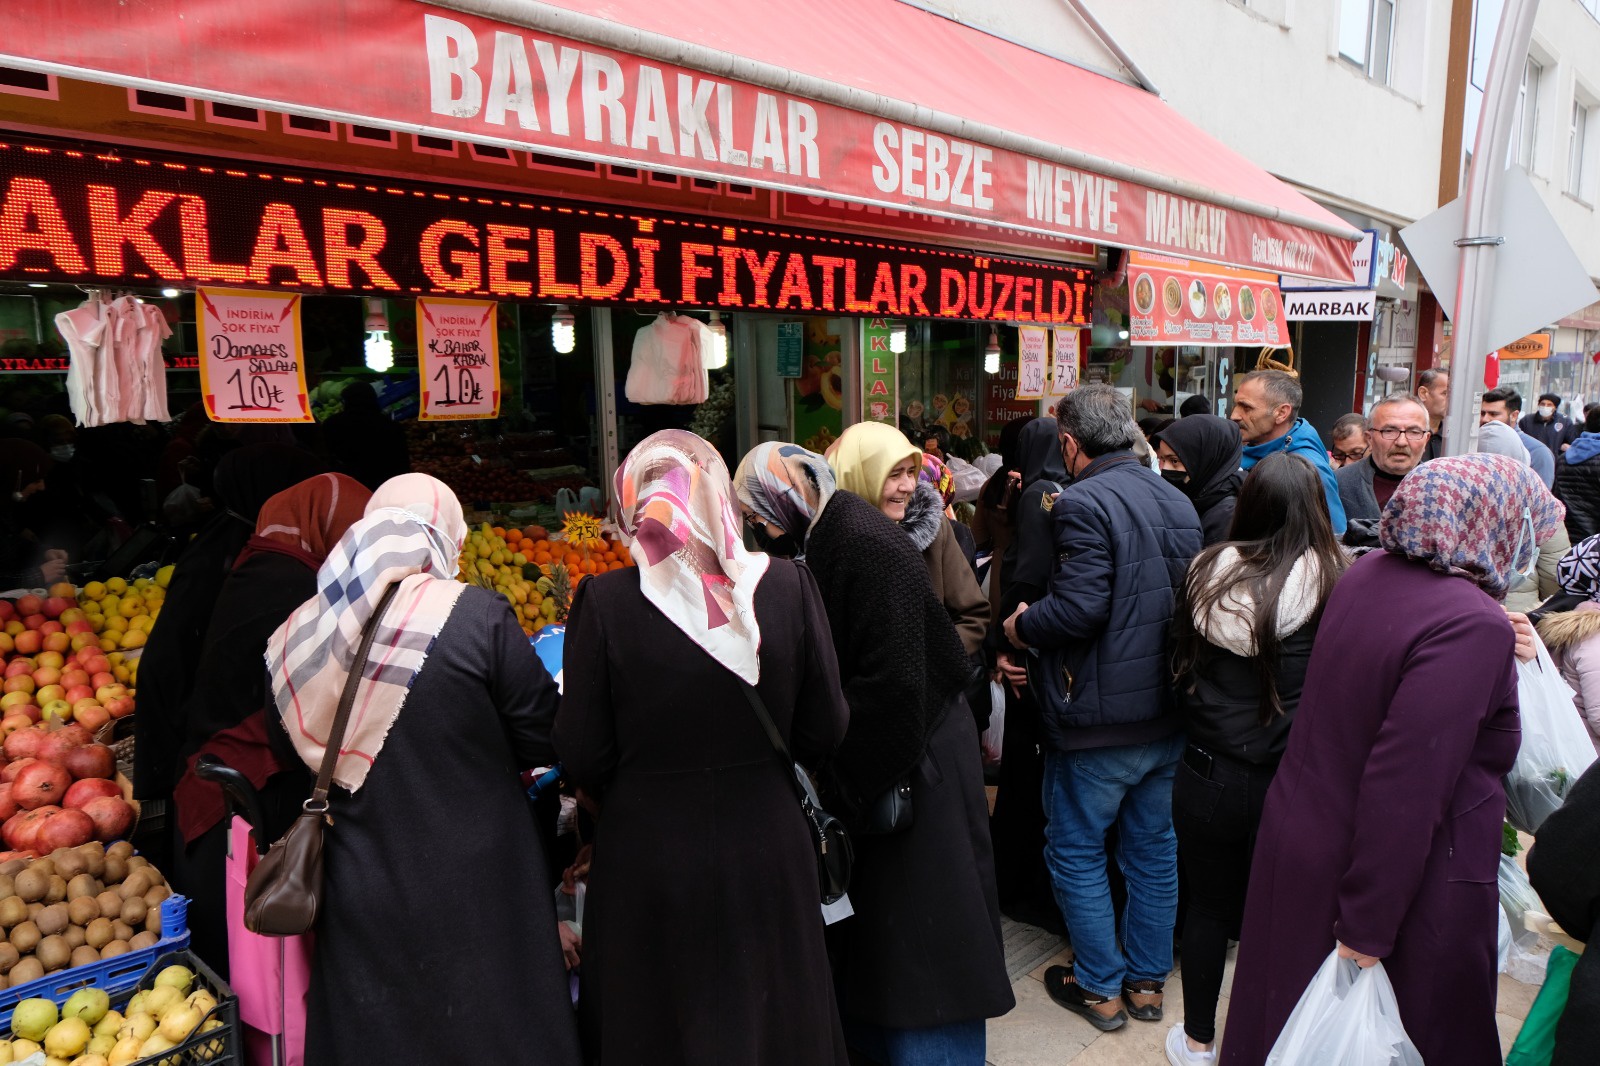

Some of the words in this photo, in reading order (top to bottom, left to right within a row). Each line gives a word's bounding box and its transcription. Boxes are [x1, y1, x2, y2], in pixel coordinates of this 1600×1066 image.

[424, 13, 821, 179] BAYRAKLAR
[872, 121, 994, 211] SEBZE
[1026, 160, 1119, 234] MEYVE
[1146, 191, 1228, 257] MANAVI
[0, 178, 400, 290] AKLAR
[419, 216, 662, 302] GELDİ
[681, 226, 931, 317] FİYATLAR
[940, 257, 1087, 325] DÜZELDİ
[227, 307, 275, 320] İNDİRİM
[1289, 302, 1370, 316] MARBAK
[440, 315, 476, 326] İNDİRİM
[221, 323, 246, 335] ŞOK
[250, 322, 280, 334] FİYAT
[436, 329, 455, 339] ŞOK
[458, 328, 481, 337] FİYAT
[453, 353, 490, 367] KABAK
